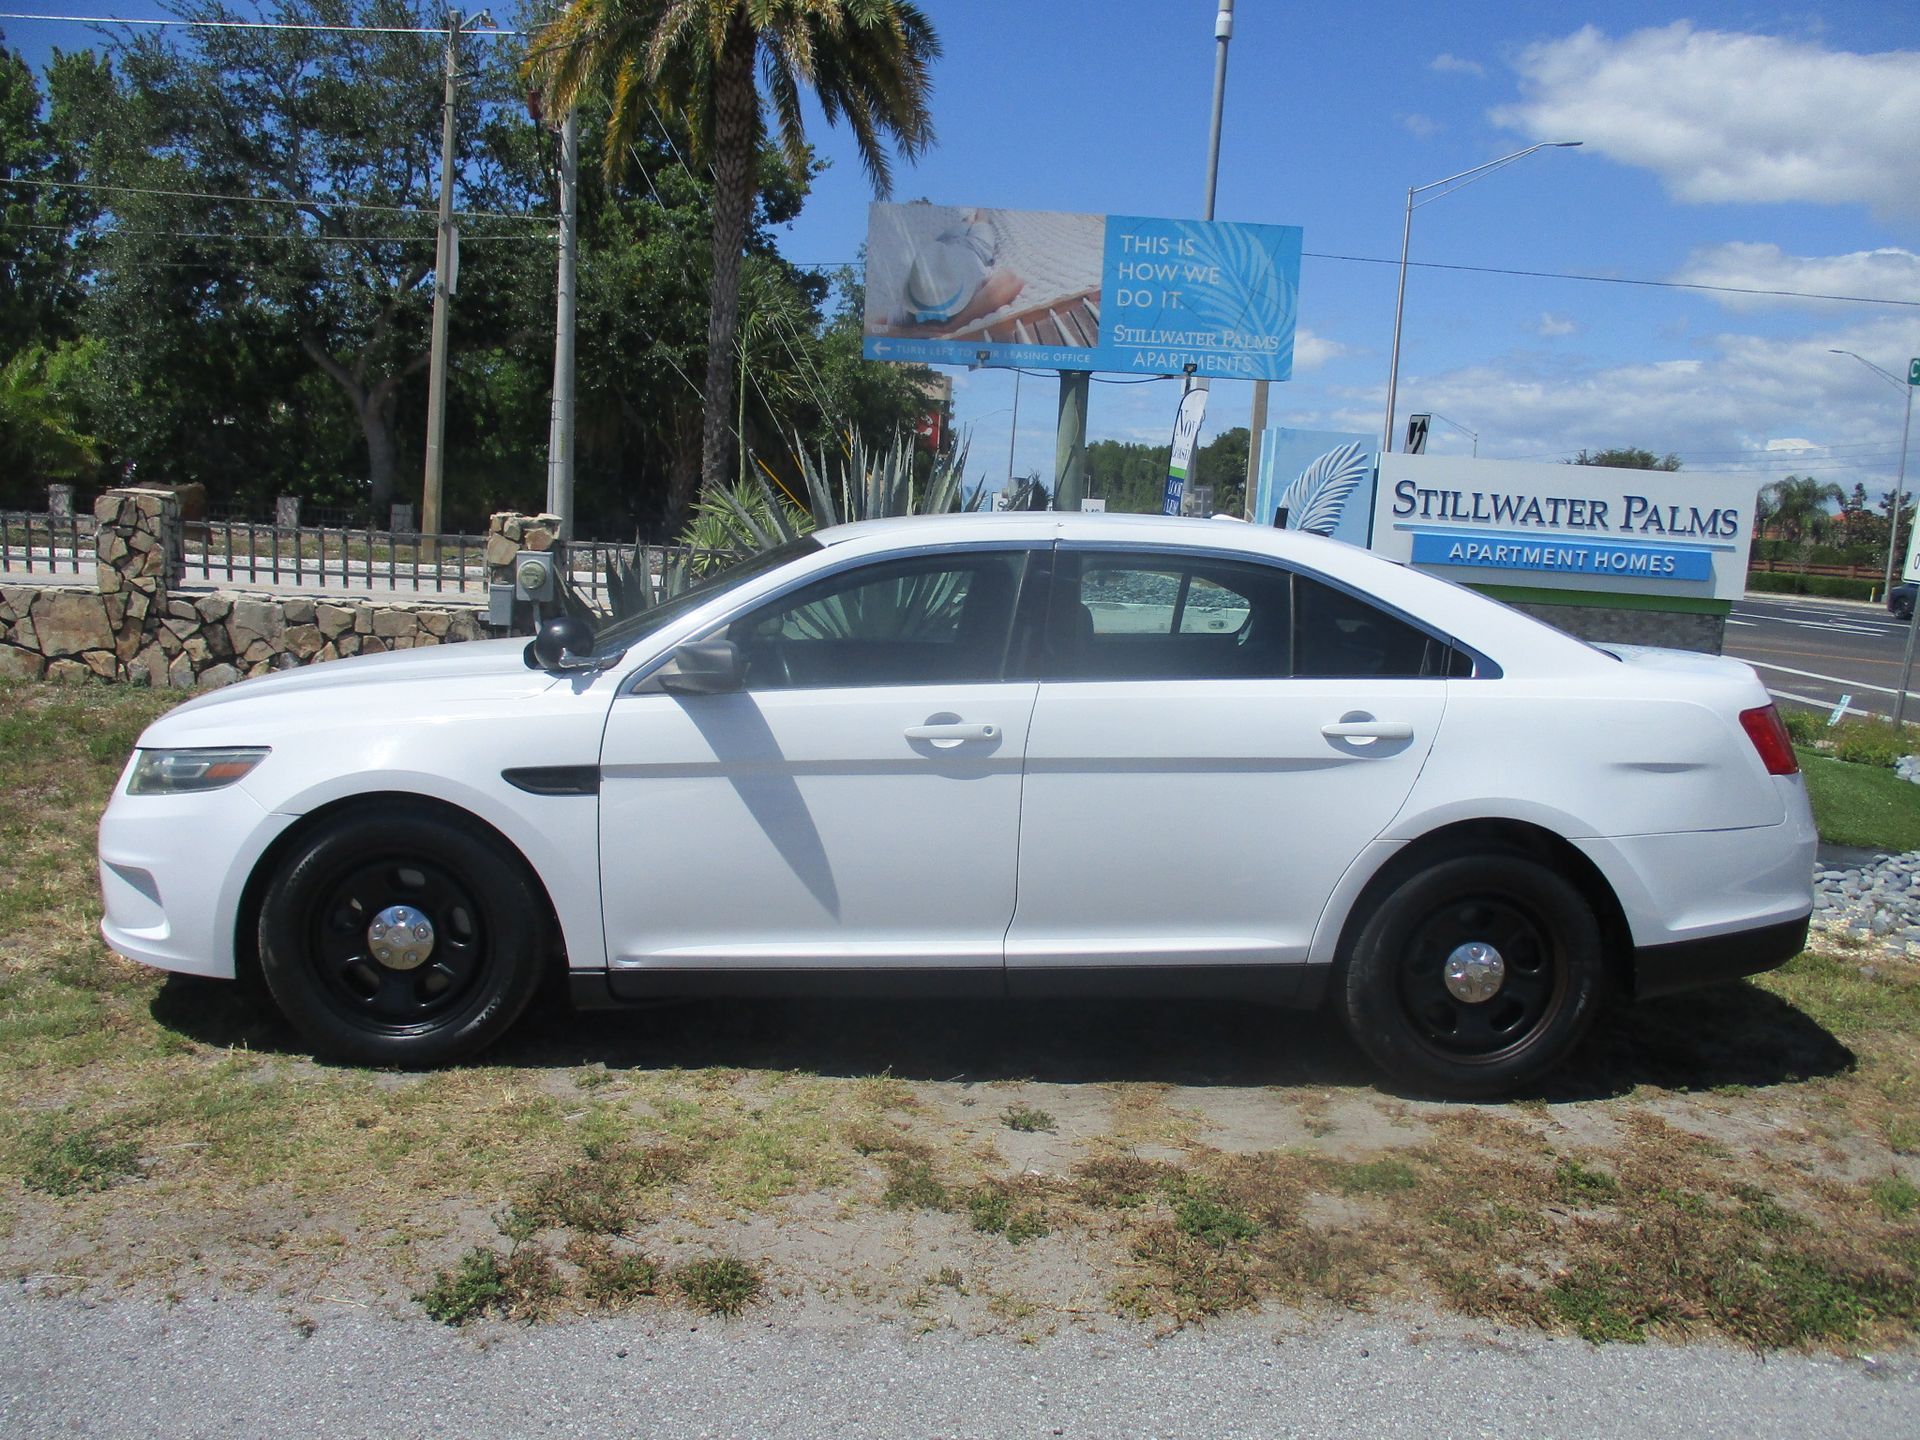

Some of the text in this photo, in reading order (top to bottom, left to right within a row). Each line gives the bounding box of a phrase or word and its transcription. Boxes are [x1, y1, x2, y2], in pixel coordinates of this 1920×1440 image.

[1120, 235, 1195, 256] THIS IS
[1118, 262, 1221, 285] HOW WE
[1116, 289, 1185, 310] DO IT.
[1113, 324, 1280, 351] STILLWATER PALMS
[896, 344, 926, 355] TURN
[930, 345, 955, 357] LEFT
[1003, 349, 1049, 362] LEASING
[1053, 352, 1091, 364] OFFICE
[1132, 351, 1253, 373] APARTMENTS
[1392, 479, 1739, 539] STILLWATER PALMS
[1448, 541, 1677, 574] APARTMENT HOMES
